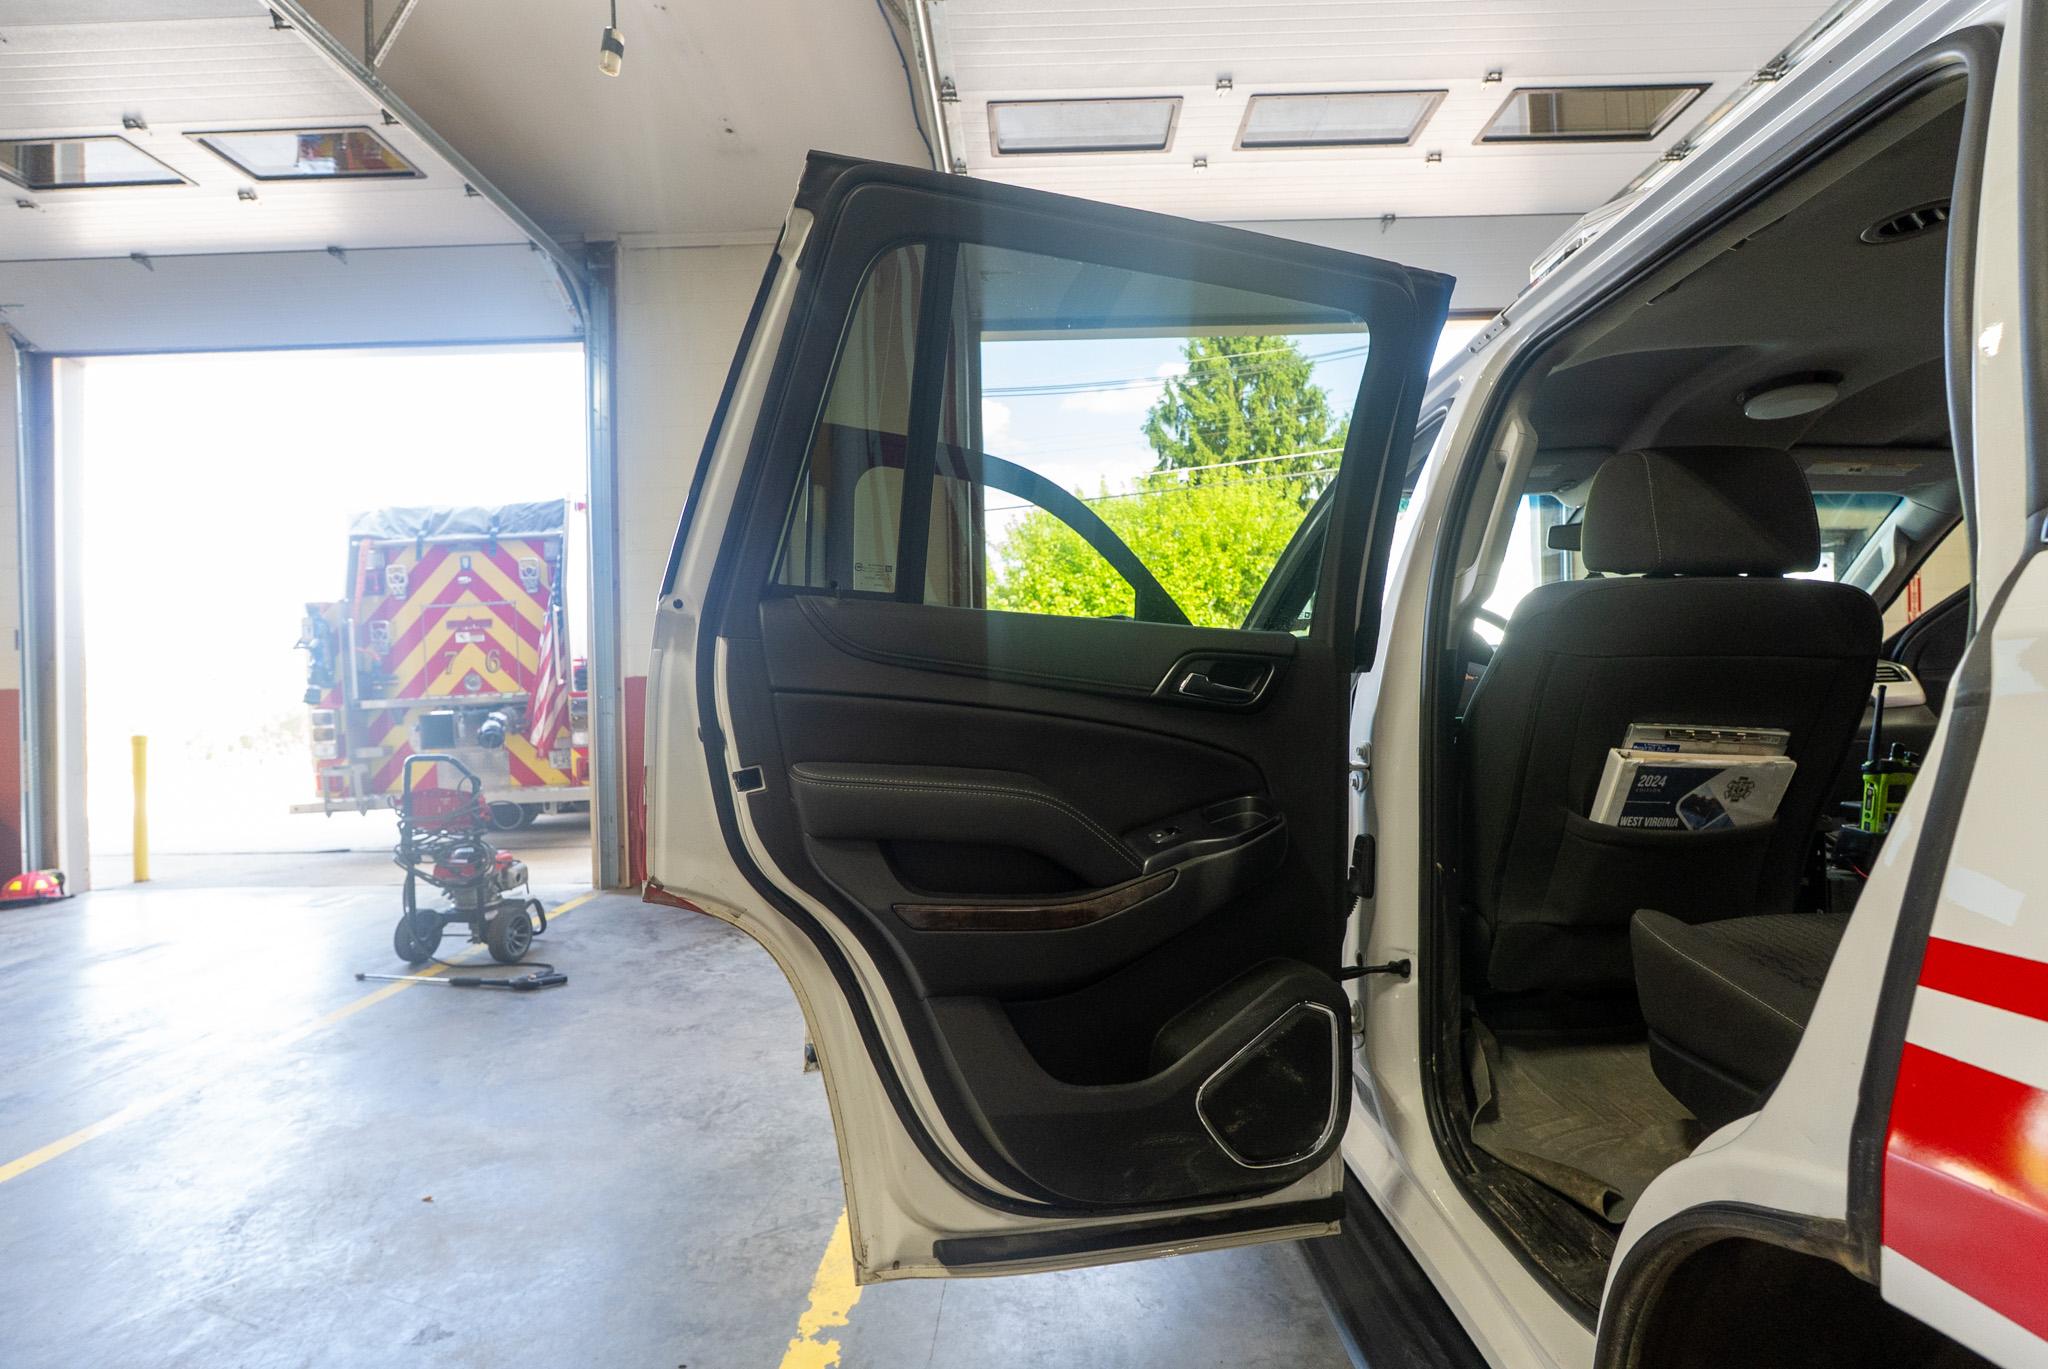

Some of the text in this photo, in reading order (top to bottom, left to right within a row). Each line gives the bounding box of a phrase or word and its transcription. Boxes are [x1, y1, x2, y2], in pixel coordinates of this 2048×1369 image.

[1638, 775, 1668, 787] 2024
[1620, 816, 1679, 827] WEST VIRGINIA
